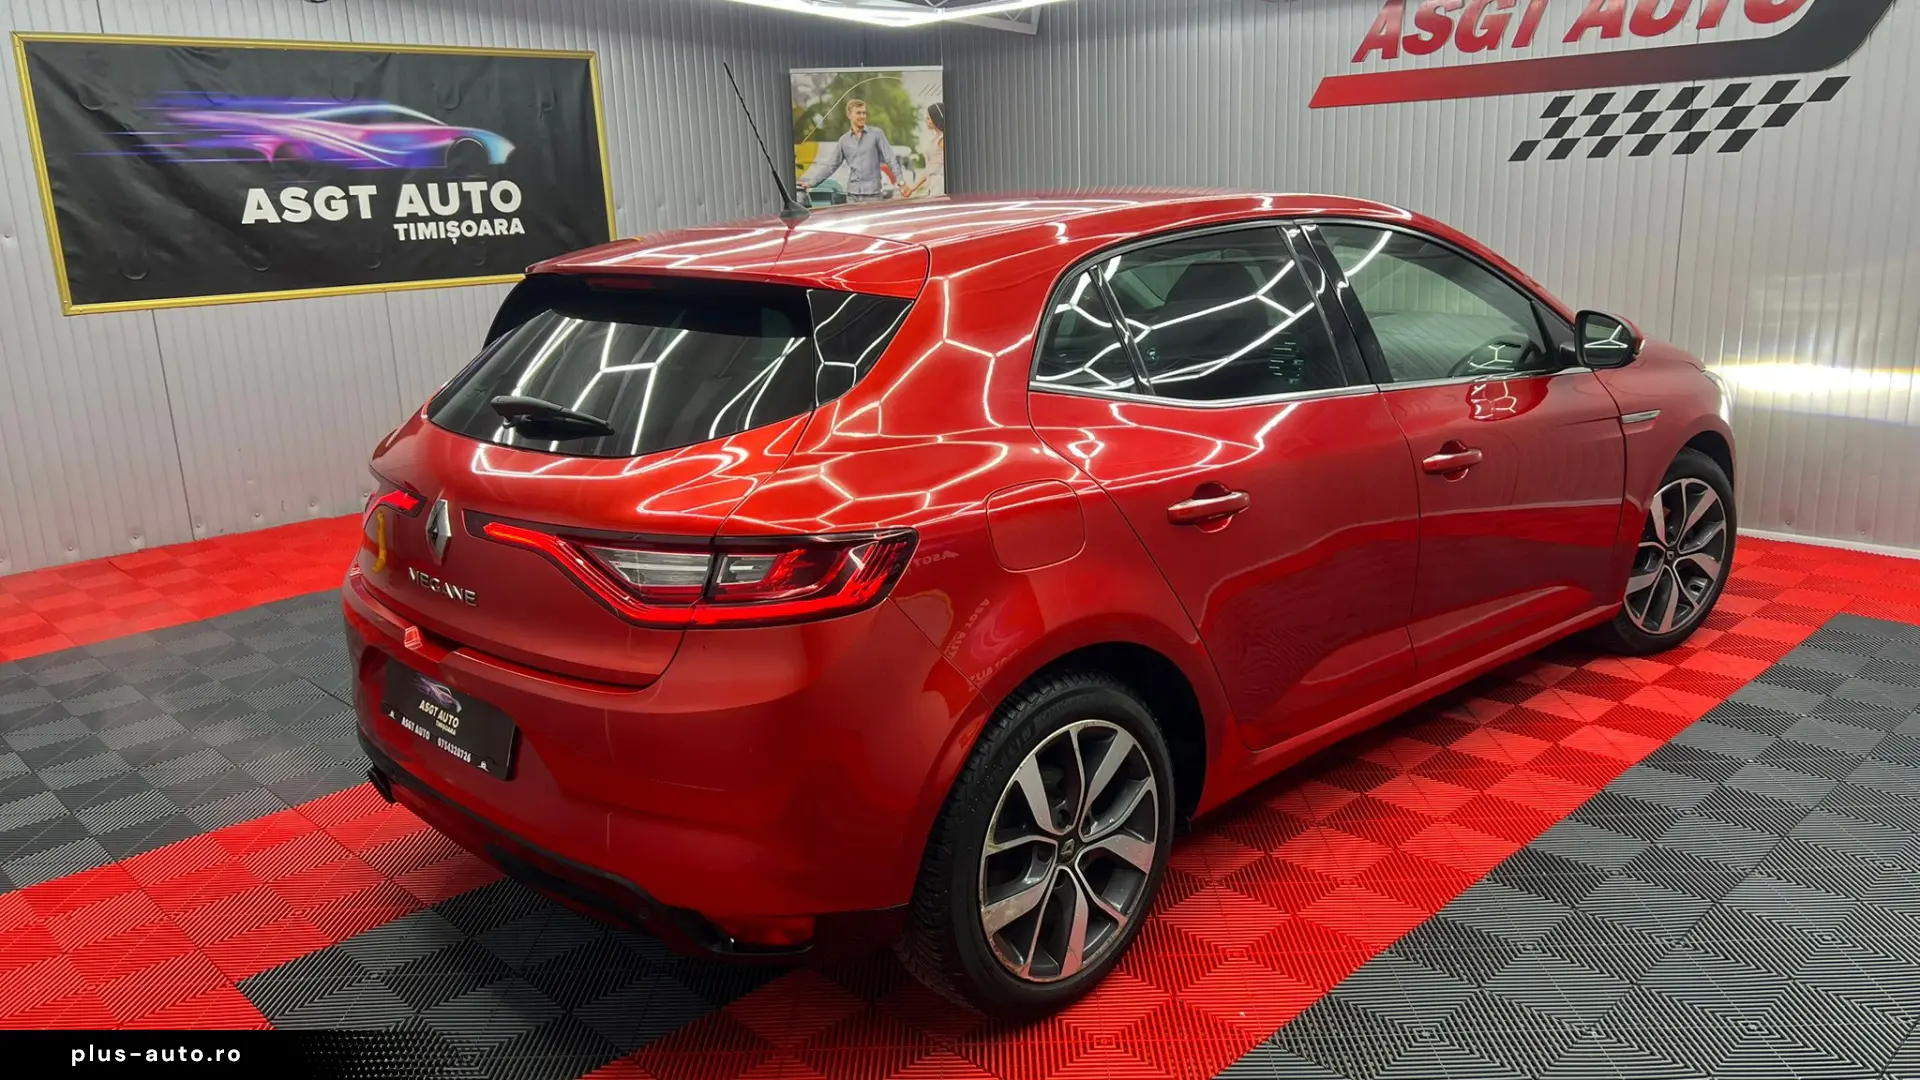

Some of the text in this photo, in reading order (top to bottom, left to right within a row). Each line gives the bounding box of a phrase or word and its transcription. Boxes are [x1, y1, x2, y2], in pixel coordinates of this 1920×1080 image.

[1351, 0, 1549, 63] ASGT
[242, 180, 522, 224] ASGT AUTO
[393, 217, 525, 245] TIMIȘOARA
[408, 567, 477, 607] MEGANE
[401, 716, 415, 731] ASGT
[415, 725, 430, 740] AUTO
[419, 700, 460, 729] ASGT AUTO
